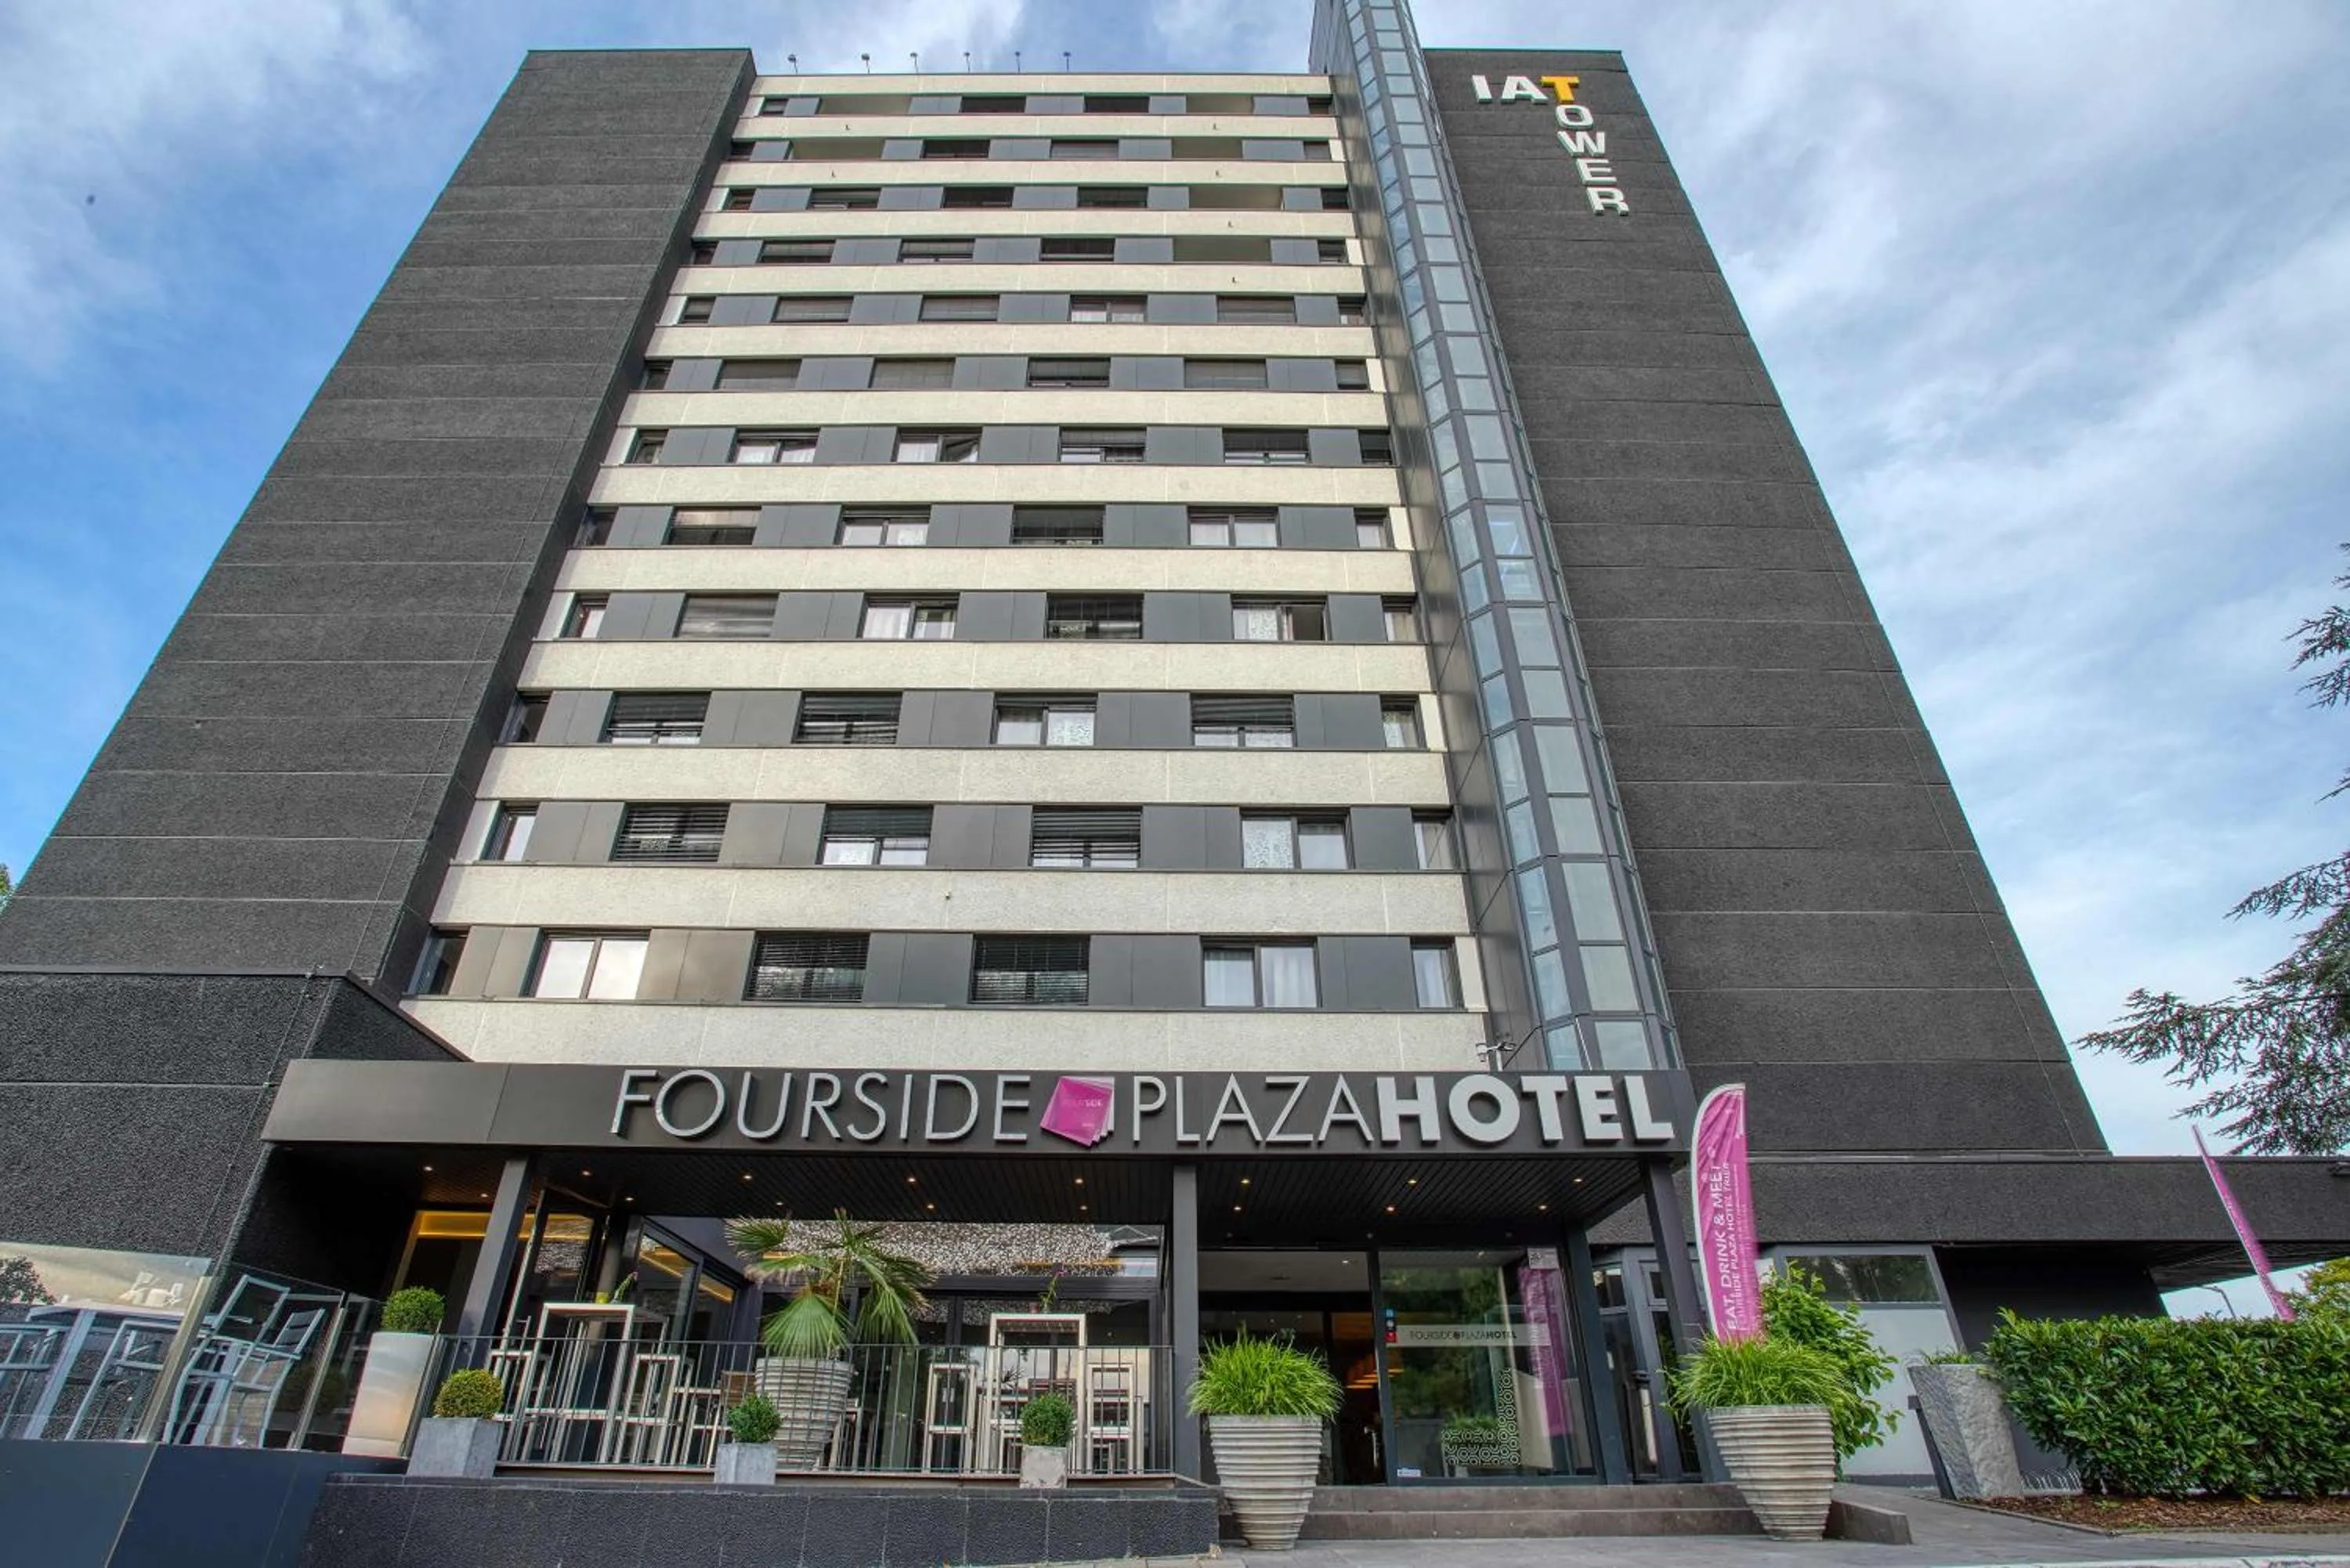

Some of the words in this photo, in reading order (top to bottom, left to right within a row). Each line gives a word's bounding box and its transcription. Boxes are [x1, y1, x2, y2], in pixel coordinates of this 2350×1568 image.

[610, 1070, 1031, 1142] FOURSIDE
[1710, 1165, 1724, 1209] MEET
[1713, 1212, 1725, 1227] &
[1724, 1194, 1735, 1230] HOTEL
[1715, 1230, 1732, 1288] DRINK
